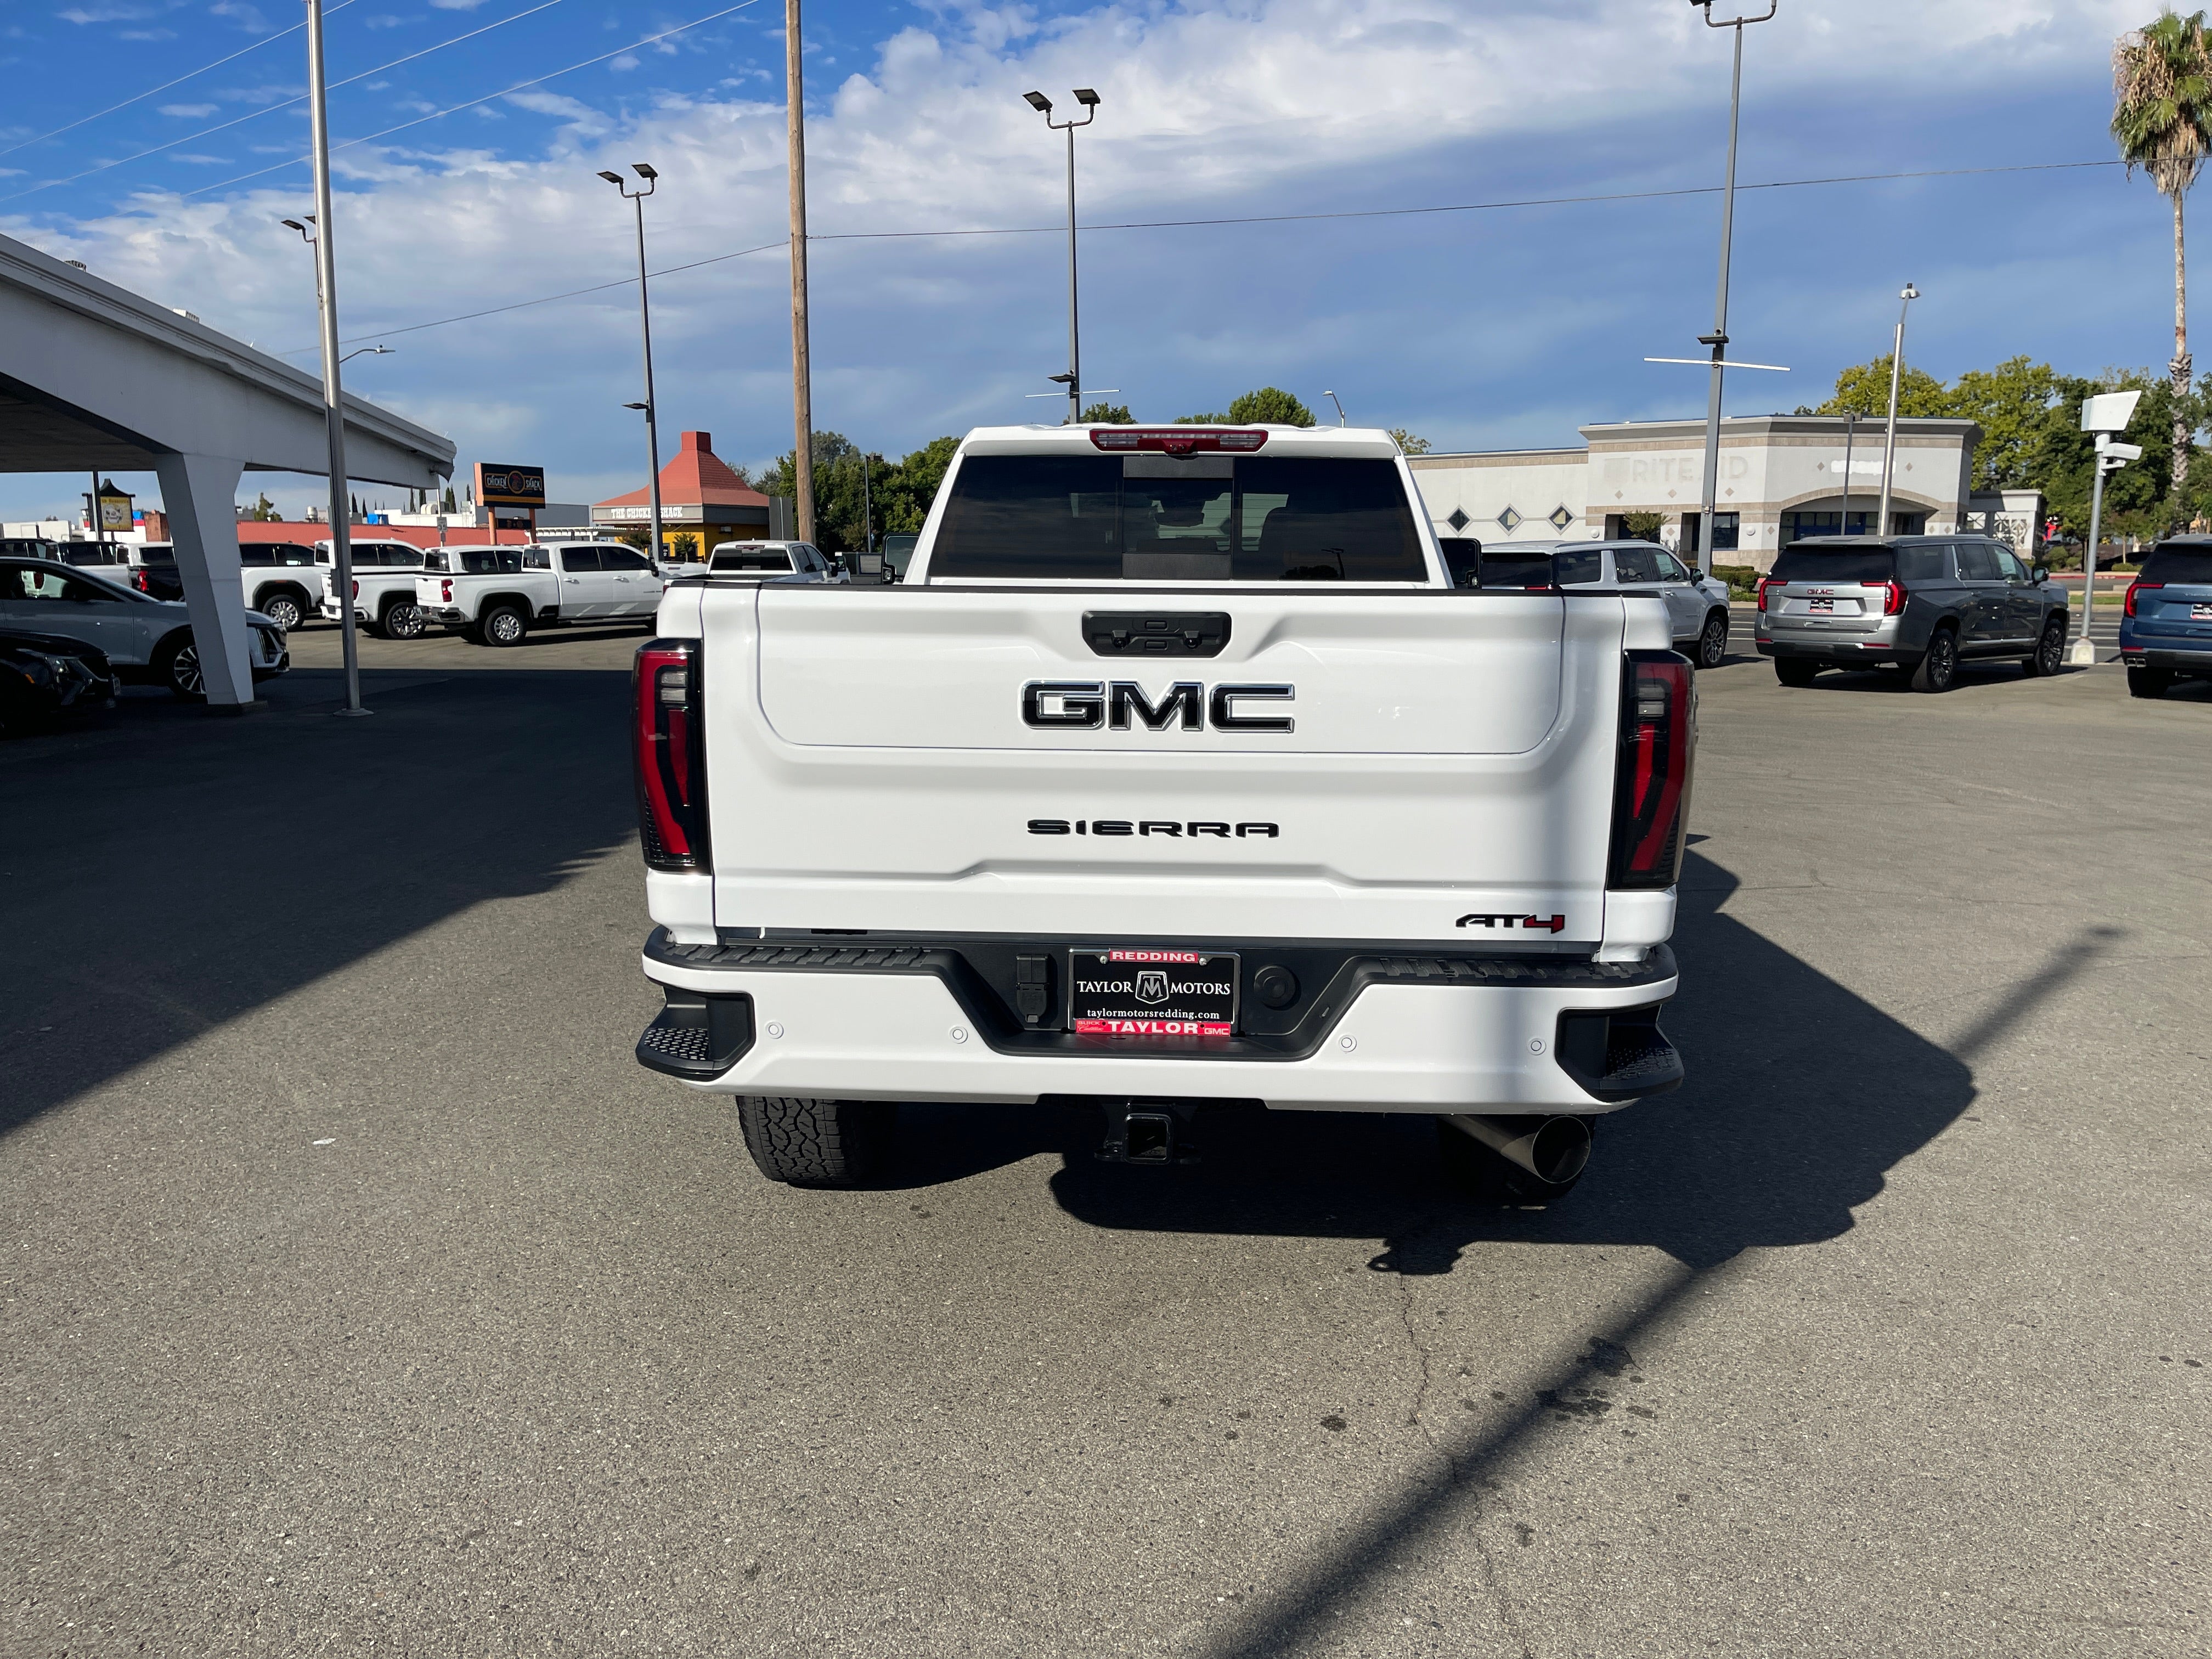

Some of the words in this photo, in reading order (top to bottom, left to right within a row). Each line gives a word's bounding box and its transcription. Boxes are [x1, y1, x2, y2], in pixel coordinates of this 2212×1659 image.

[1632, 458, 1694, 482] RITE
[1698, 455, 1748, 479] ID
[487, 475, 508, 489] CHICKEN
[526, 477, 543, 491] SHACK
[611, 508, 625, 519] THE
[627, 507, 652, 519] CHICKE
[1021, 678, 1295, 734] GMC
[1027, 819, 1280, 838] SIERRA
[1455, 913, 1566, 934] AT4
[1112, 951, 1195, 962] REDDING
[1076, 981, 1134, 993] TAYLOR
[1170, 982, 1231, 995] MOTORS
[1087, 1008, 1220, 1020] taylormotorsredding.com
[1107, 1020, 1198, 1034] TAYLOR
